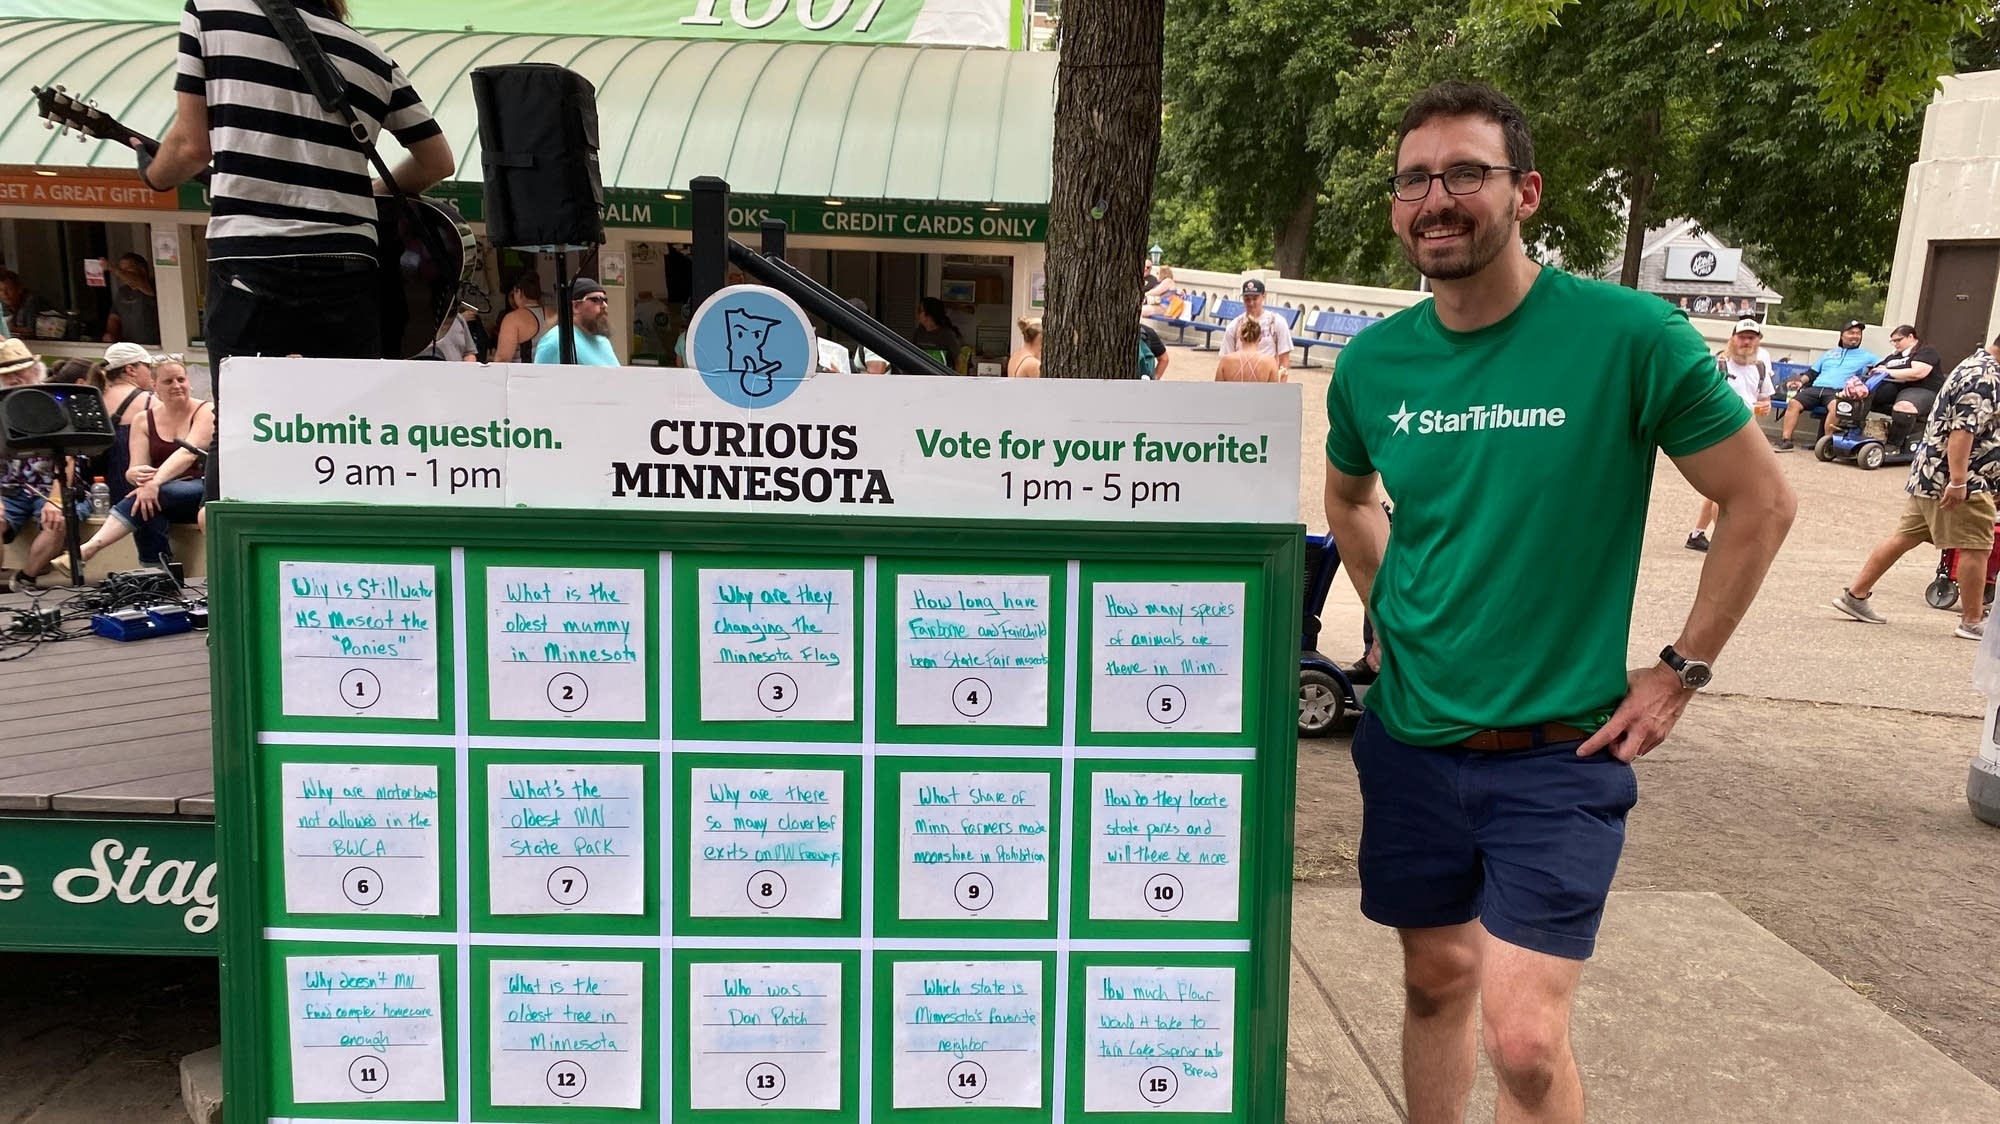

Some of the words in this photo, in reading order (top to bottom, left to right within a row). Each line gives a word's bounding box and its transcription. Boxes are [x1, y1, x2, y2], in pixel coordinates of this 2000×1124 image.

[34, 186, 46, 199] A
[51, 185, 104, 201] GREAT
[728, 207, 769, 227] OKS
[822, 211, 897, 233] CREDIT
[903, 214, 974, 234] CARDS
[980, 217, 1036, 237] ONLY
[253, 413, 371, 444] Submit
[381, 424, 399, 445] a
[408, 418, 562, 453] question.
[650, 420, 857, 460] CURIOUS
[916, 429, 991, 458] Vote
[999, 430, 1045, 460] for
[1053, 438, 1125, 467] your
[1133, 432, 1269, 463] favorite!
[315, 455, 335, 484] 9
[345, 465, 395, 486] am
[426, 458, 437, 487] 1
[450, 466, 500, 494] pm
[612, 462, 894, 504] MINNESOTA
[1001, 471, 1011, 499] 1
[1023, 479, 1072, 506] pm
[1103, 473, 1121, 501] 5
[1132, 481, 1180, 508] pm
[292, 577, 328, 605] Why
[336, 580, 352, 598] is
[507, 582, 550, 602] What
[566, 587, 580, 601] is
[589, 582, 620, 603] the
[719, 585, 753, 612] Why
[761, 589, 791, 604] are
[796, 584, 832, 614] they
[914, 589, 951, 609] How
[959, 591, 1000, 616] long
[1003, 592, 1038, 608] have
[1105, 595, 1137, 616] How
[1145, 604, 1183, 625] many
[1191, 602, 1234, 625] species
[296, 610, 320, 627] HS
[401, 611, 428, 629] the
[563, 621, 629, 643] mummy
[978, 623, 999, 637] and
[1110, 629, 1124, 645] of
[1131, 628, 1184, 646] animals
[511, 646, 528, 662] in
[720, 647, 792, 663] Minnesota
[801, 647, 840, 666] Flag
[944, 650, 985, 668] State
[985, 648, 1011, 668] Fair
[1154, 661, 1168, 675] in
[356, 682, 364, 696] 1
[563, 686, 573, 699] 2
[773, 686, 783, 699] 3
[967, 691, 977, 704] 4
[1161, 698, 1172, 711] 5
[303, 778, 332, 805] Why
[343, 788, 364, 797] are
[509, 780, 564, 799] What's
[572, 779, 601, 801] the
[710, 784, 739, 809] Why
[750, 790, 773, 801] are
[786, 786, 828, 803] there
[920, 786, 960, 805] What
[1012, 791, 1026, 804] of
[1106, 788, 1130, 806] How
[1134, 789, 1148, 806] do
[1153, 790, 1181, 813] they
[1191, 790, 1228, 807] locate
[299, 811, 320, 827] not
[386, 813, 402, 828] in
[408, 812, 431, 827] the
[574, 804, 605, 827] MN
[734, 817, 767, 838] many
[1019, 822, 1046, 833] made
[1107, 818, 1139, 835] state
[1147, 822, 1180, 842] parks
[1187, 819, 1211, 834] and
[333, 838, 386, 856] BWCA
[704, 843, 748, 859] exits
[755, 850, 771, 861] on
[1108, 845, 1131, 862] will
[1134, 846, 1170, 862] there
[1177, 847, 1191, 862] be
[1200, 853, 1228, 863] more
[981, 853, 990, 862] in
[357, 880, 369, 893] 6
[562, 880, 573, 893] 7
[761, 883, 772, 896] 8
[968, 885, 979, 898] 9
[1154, 887, 1173, 900] 10
[306, 972, 333, 995] Why
[395, 973, 414, 988] MN
[509, 974, 540, 993] What
[550, 981, 564, 994] is
[573, 976, 599, 995] the
[724, 979, 751, 996] Who
[768, 984, 801, 997] was
[924, 979, 960, 995] Which
[972, 978, 1006, 995] state
[1013, 985, 1024, 994] is
[1134, 985, 1168, 1000] much
[509, 1003, 553, 1022] oldest
[563, 1004, 592, 1022] tree
[602, 1010, 616, 1022] in
[729, 1008, 760, 1025] Dan
[771, 1006, 807, 1025] Patch
[1155, 1015, 1182, 1029] take
[1191, 1015, 1205, 1028] to
[340, 1031, 389, 1052] enough
[530, 1032, 618, 1051] Minnesota
[939, 1036, 988, 1059] neighbor
[1130, 1040, 1154, 1055] Lake
[1205, 1042, 1223, 1057] into
[361, 1068, 377, 1081] 11
[1183, 1062, 1217, 1078] Bread
[558, 1073, 576, 1086] 12
[757, 1075, 775, 1088] 13
[958, 1074, 976, 1086] 14
[1149, 1079, 1167, 1091] 15
